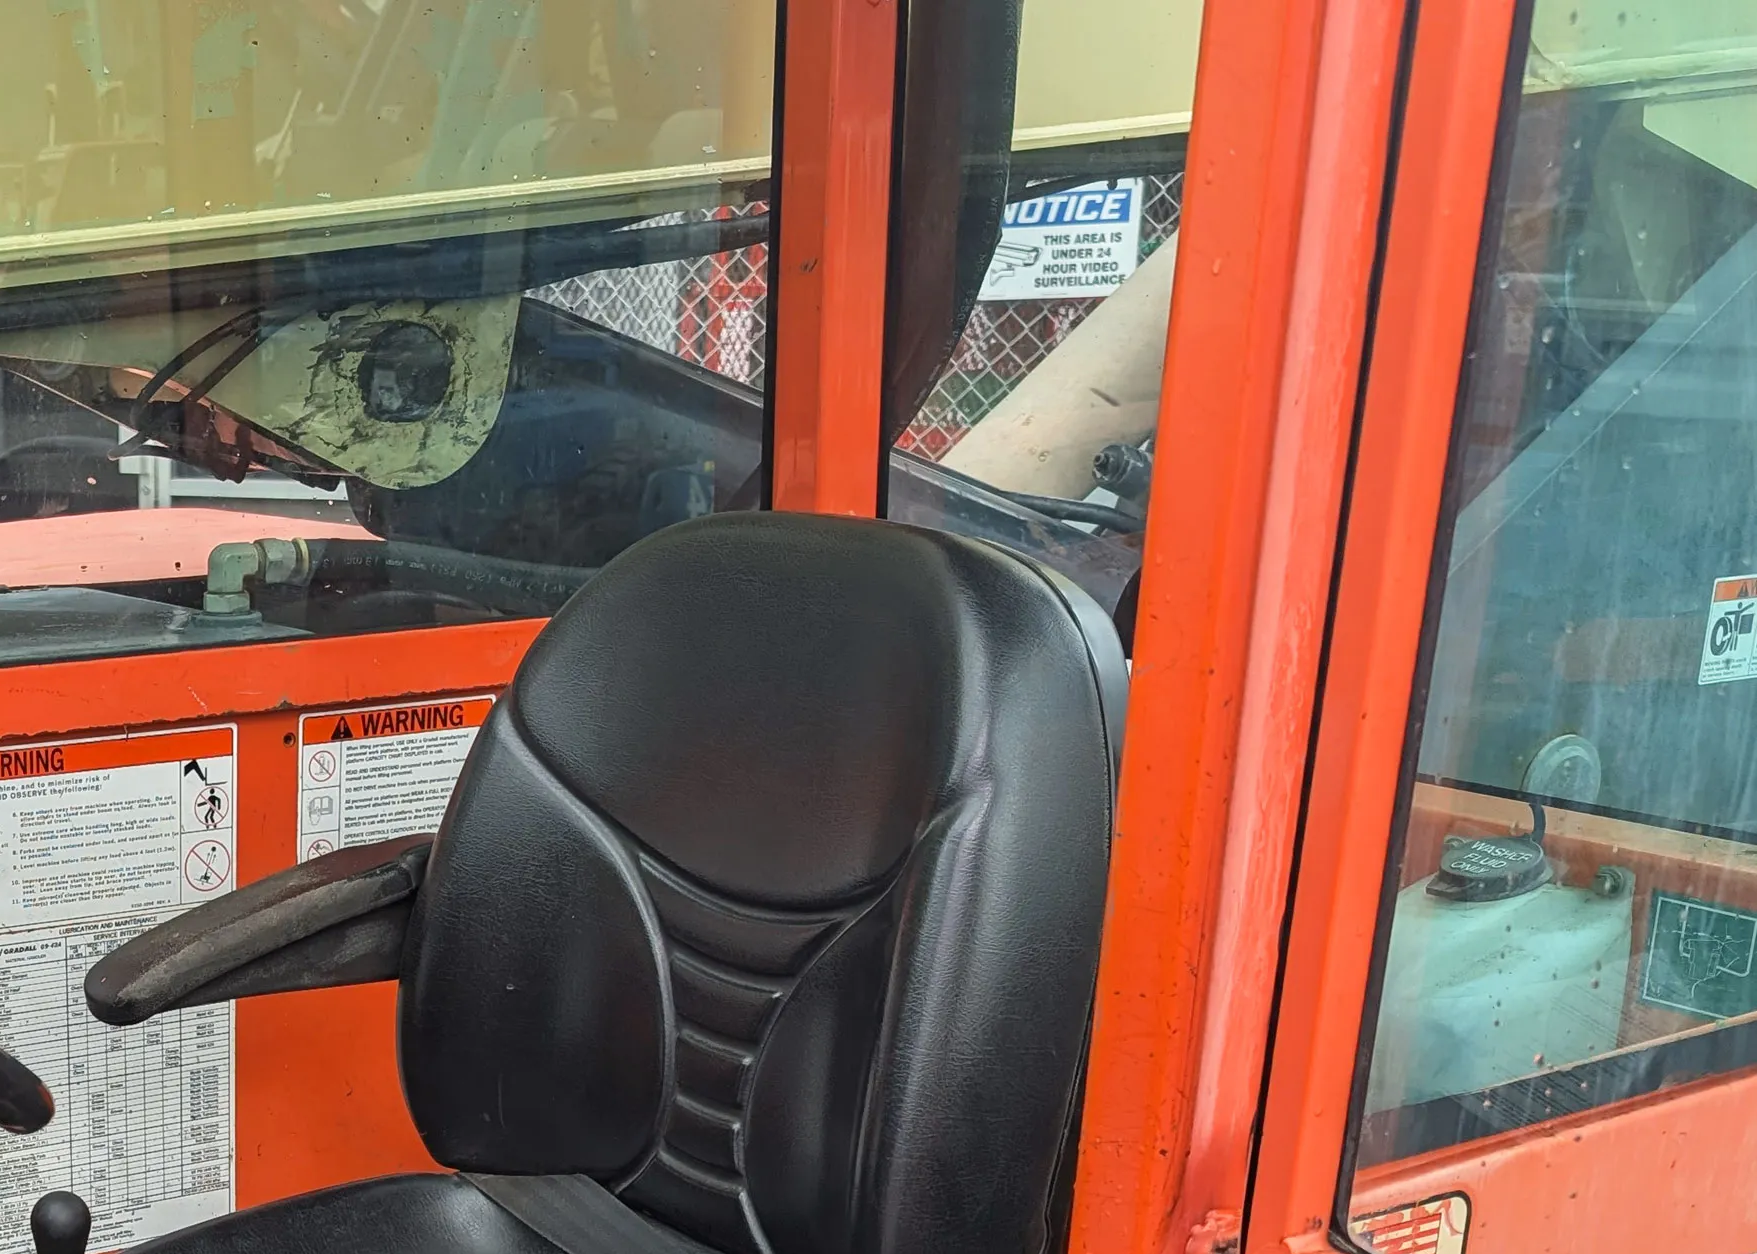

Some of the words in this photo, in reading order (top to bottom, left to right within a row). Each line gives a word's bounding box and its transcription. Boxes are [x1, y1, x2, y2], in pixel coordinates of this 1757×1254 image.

[1043, 234, 1071, 246] THIS
[1074, 232, 1107, 244] AREA
[1110, 232, 1122, 243] IS
[1051, 248, 1093, 260] UNDER
[1097, 247, 1112, 258] 24
[1043, 263, 1077, 274] HOUR
[1081, 261, 1119, 273] VIDEO
[1034, 274, 1127, 289] SURVEILLANCE
[361, 705, 464, 736] WARNING
[21, 781, 34, 789] and
[47, 776, 82, 786] minimize
[85, 774, 99, 782] risk
[11, 789, 46, 799] OBSERVE
[1471, 840, 1533, 861] WASHER
[1450, 861, 1491, 874] ONLY
[1463, 852, 1507, 869] FLUID
[58, 924, 99, 935] LUBRICATION
[114, 916, 158, 927] MAINTENANCE
[93, 932, 118, 941] SERVICE
